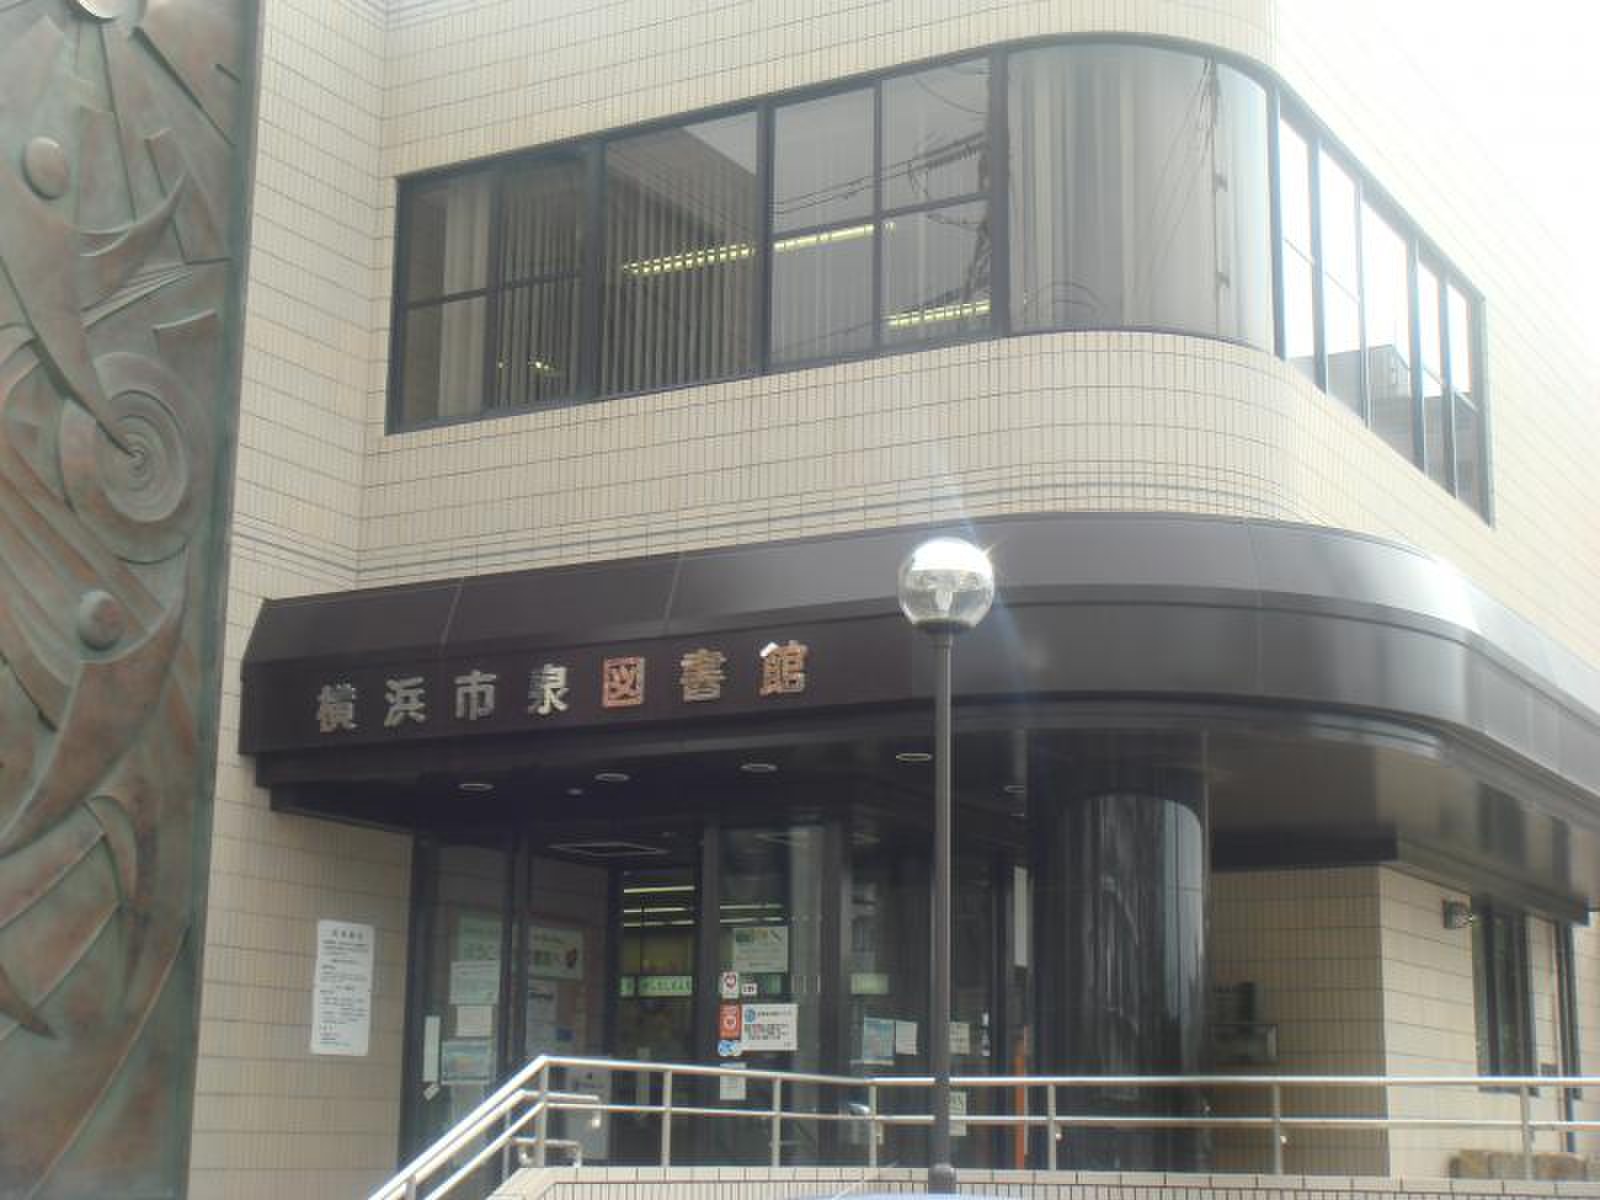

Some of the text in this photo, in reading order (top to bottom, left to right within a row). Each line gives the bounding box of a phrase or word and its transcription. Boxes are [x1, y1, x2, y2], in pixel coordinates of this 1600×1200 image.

[316, 640, 808, 733] 横浜市泉図書館
